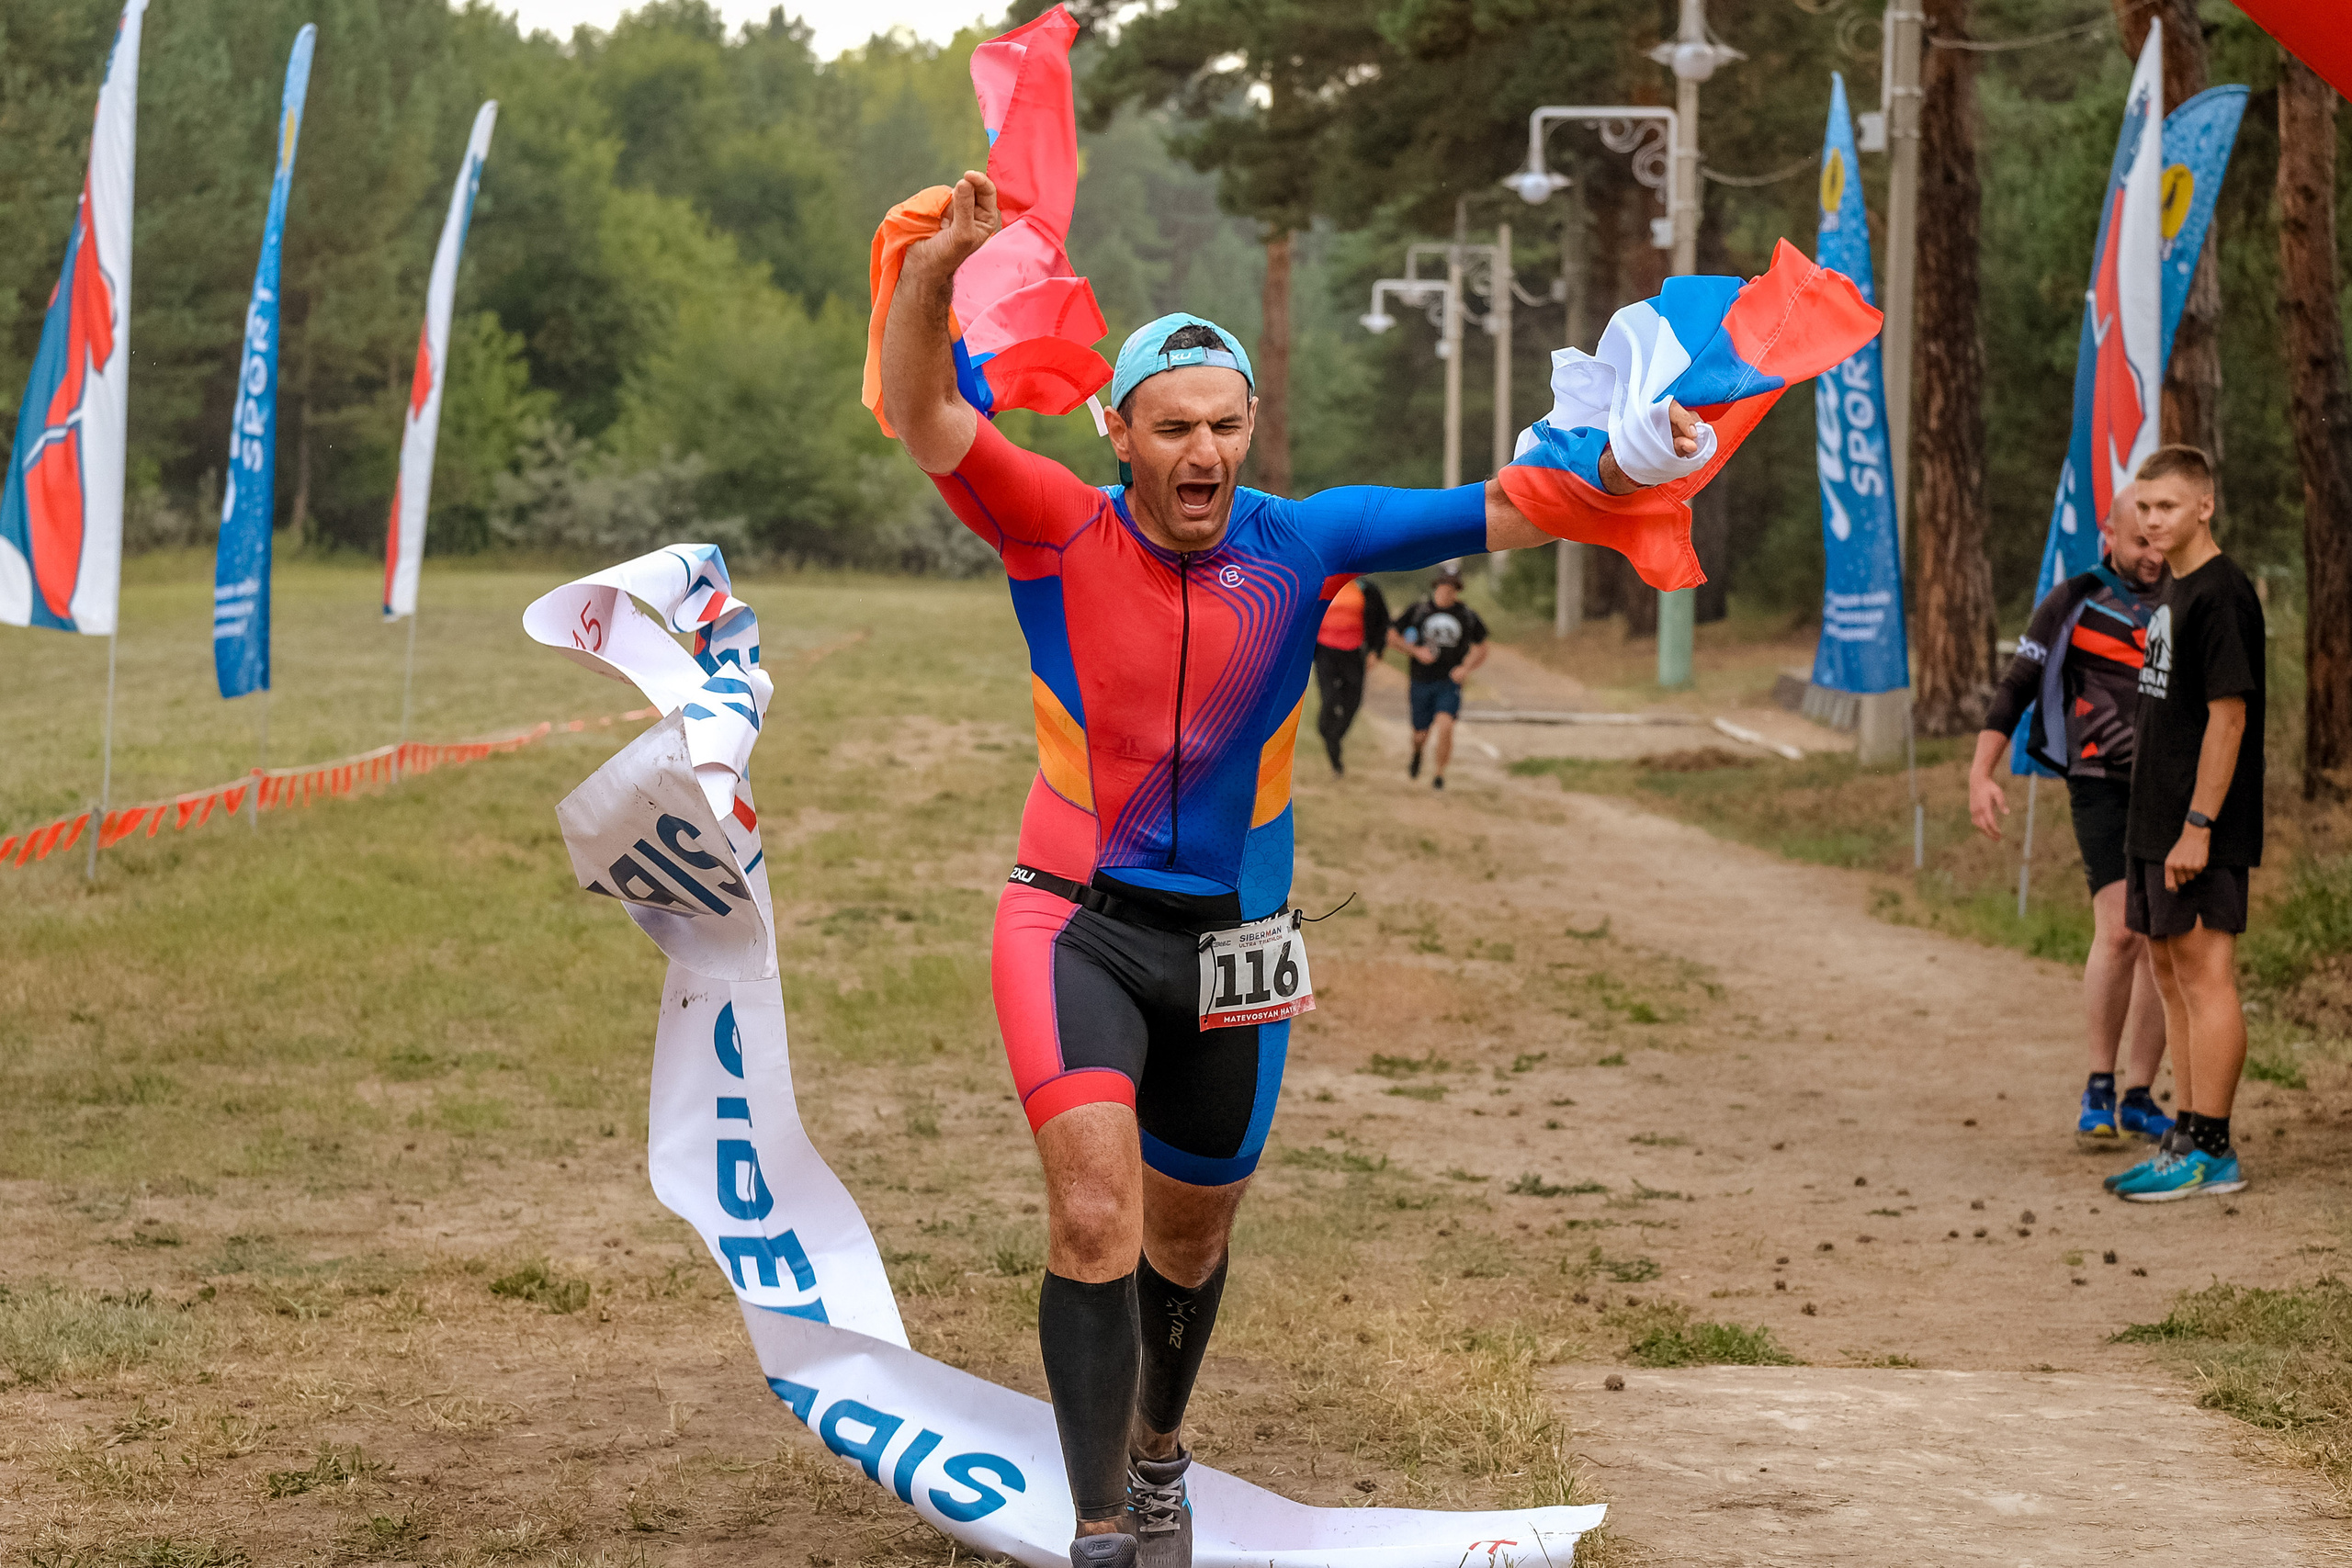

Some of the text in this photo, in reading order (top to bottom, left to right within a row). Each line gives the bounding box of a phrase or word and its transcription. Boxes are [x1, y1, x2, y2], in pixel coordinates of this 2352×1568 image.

[1170, 352, 1193, 361] XU
[1841, 355, 1883, 497] SPOR
[586, 813, 752, 919] SIB
[1010, 866, 1036, 883] 2XU
[1239, 926, 1282, 942] SIBERMAN
[1215, 940, 1299, 1008] 116
[1223, 1010, 1279, 1023] MATEVOSYAN
[1169, 1320, 1184, 1349] 2XU
